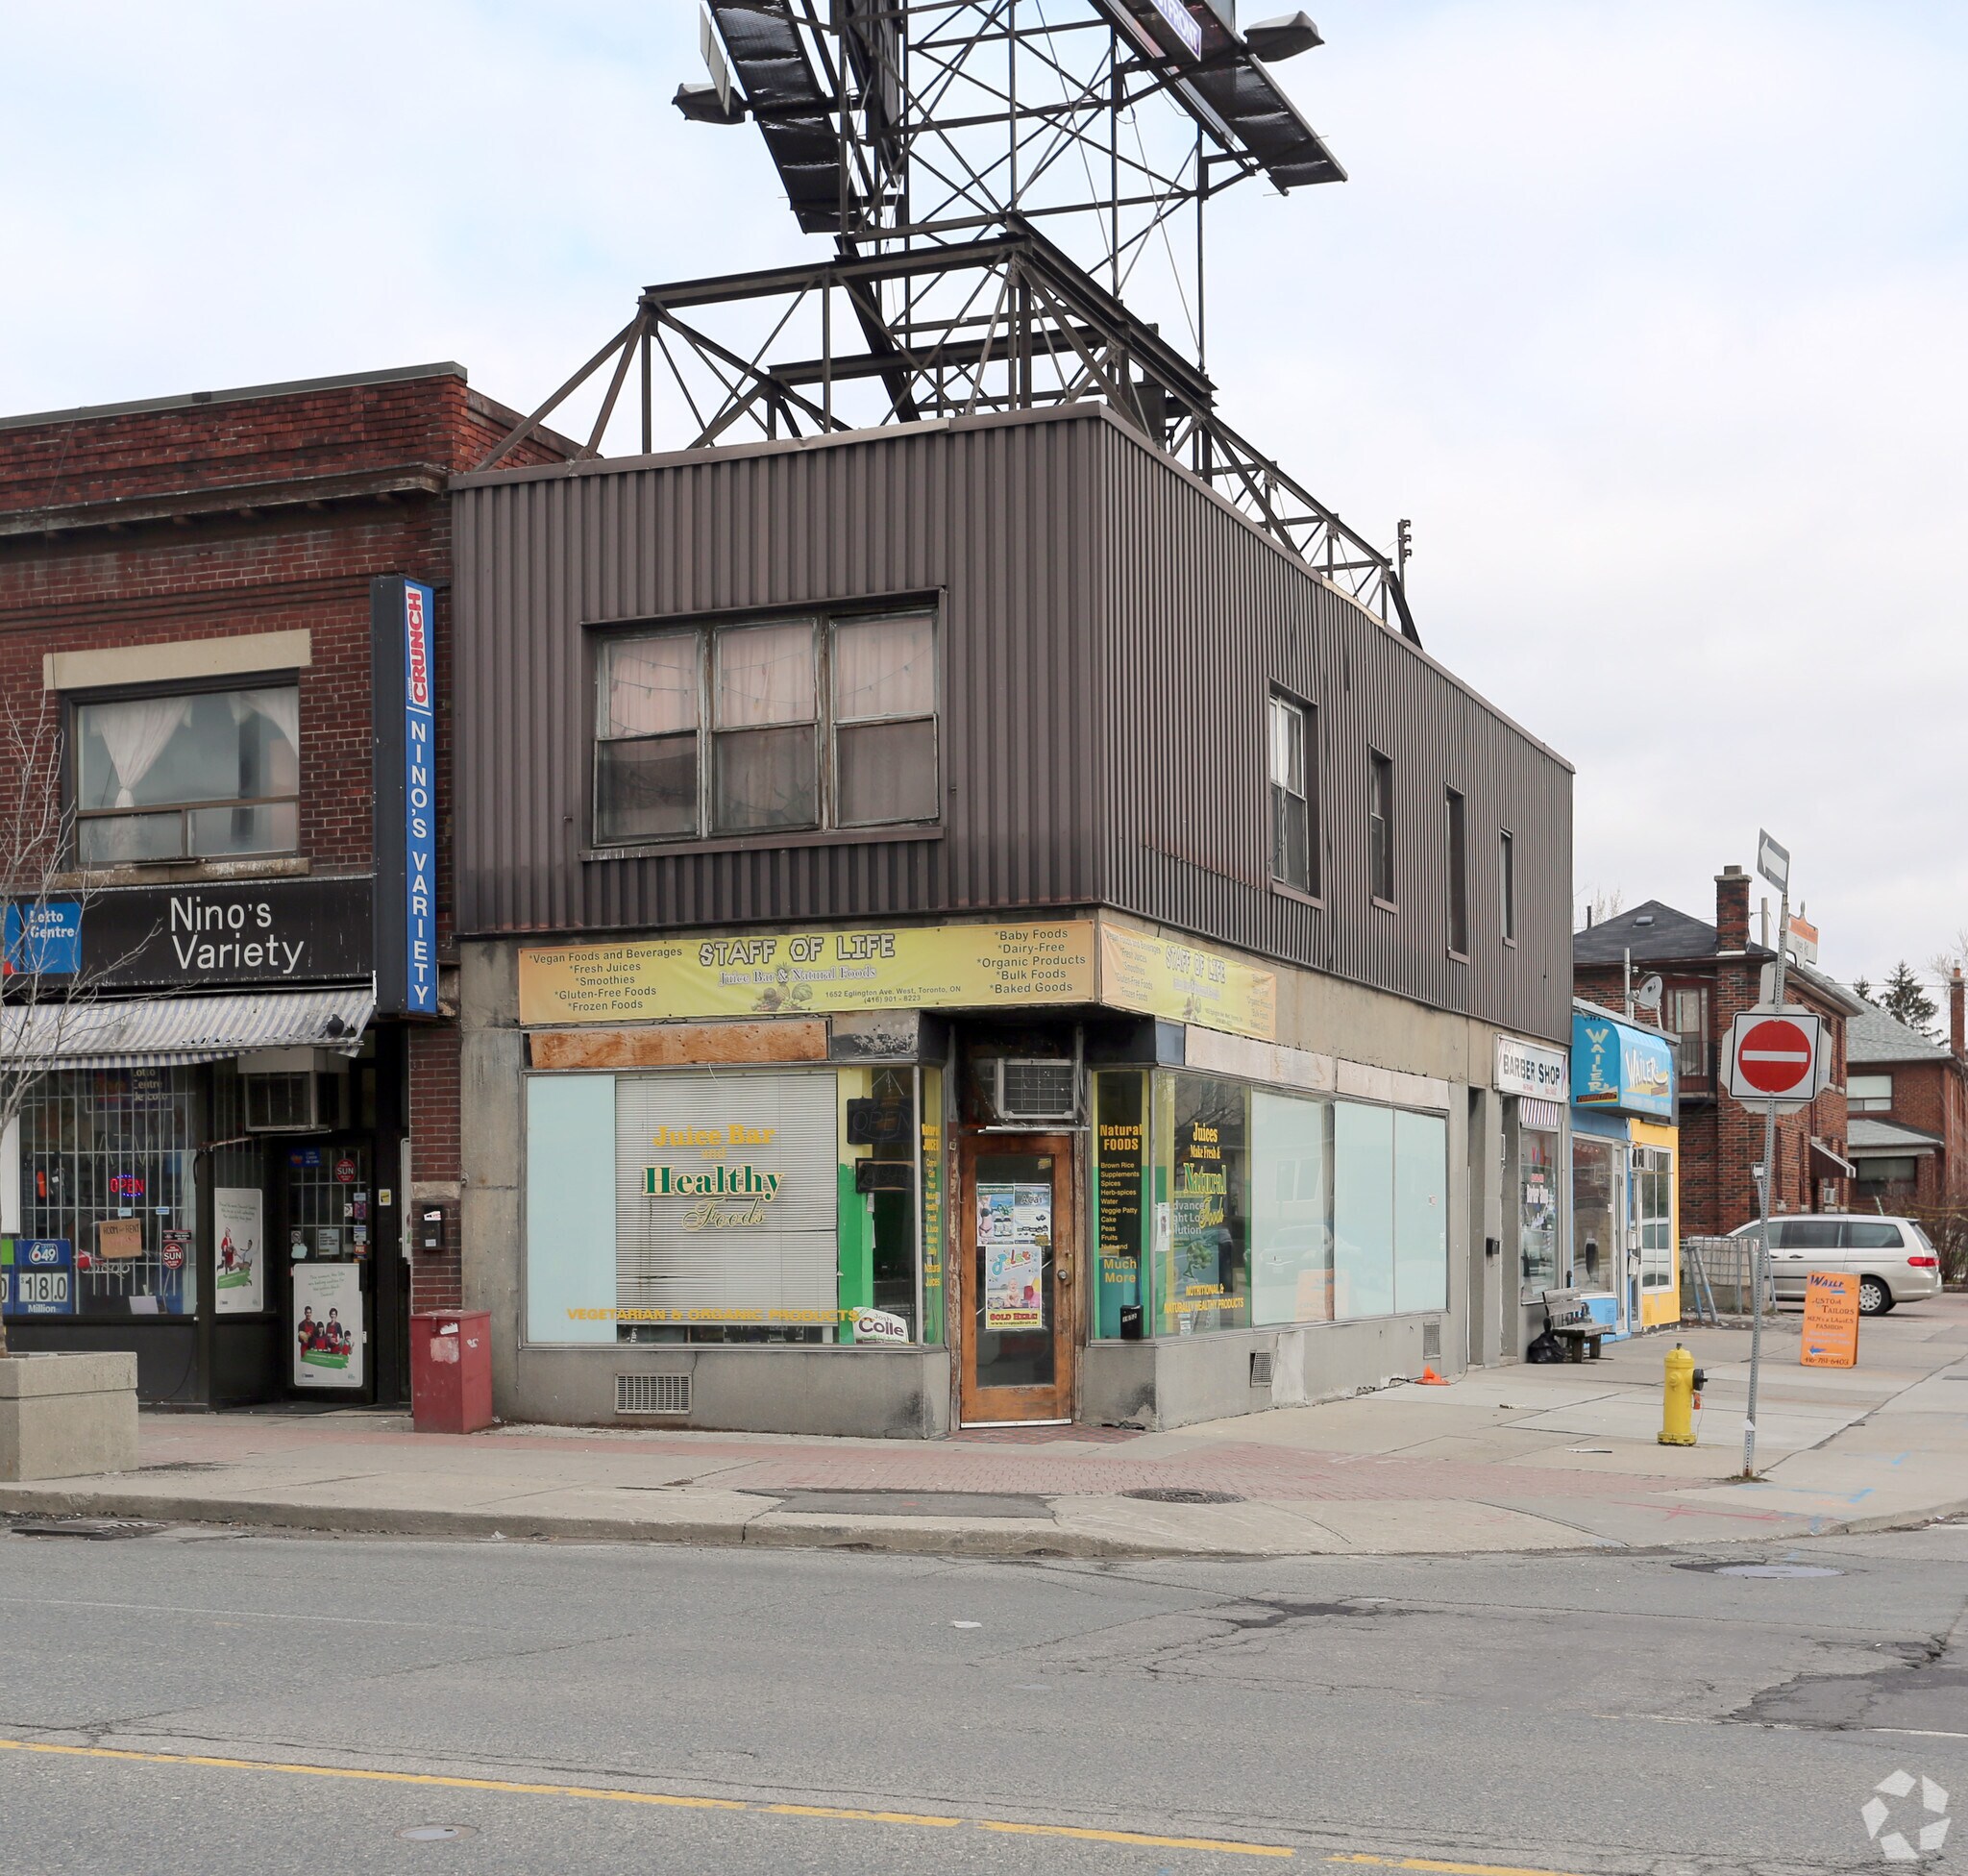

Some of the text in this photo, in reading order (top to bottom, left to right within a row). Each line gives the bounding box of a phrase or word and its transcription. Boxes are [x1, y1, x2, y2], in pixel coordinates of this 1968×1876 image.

[407, 592, 428, 704] CRUNCH
[410, 720, 430, 1005] NINO'S VARIETY
[170, 896, 272, 931] Nino's
[30, 925, 75, 938] Centre
[1032, 928, 1069, 940] Foods
[171, 932, 305, 975] Variety
[568, 950, 601, 962] Foods
[603, 949, 624, 960] and
[626, 947, 683, 960] Beverages
[699, 933, 896, 967] STAFF OF LIFE
[1032, 954, 1086, 966] Products
[1166, 945, 1226, 984] STAFF OF LIFE
[606, 962, 641, 973] Juices
[1031, 969, 1067, 979] Foods
[719, 971, 751, 986] Juice
[753, 970, 775, 983] Bar
[790, 967, 837, 981] Natural
[839, 965, 877, 980] Foods
[625, 985, 657, 997] Foods
[1035, 981, 1073, 992] Goods
[611, 999, 643, 1010] Foods
[864, 996, 883, 1004] (416)
[1503, 1053, 1561, 1086] BARBER SHOP
[652, 1123, 775, 1147] Juice Bar
[1099, 1123, 1144, 1137] Natural
[1193, 1122, 1218, 1143] Juices
[1103, 1138, 1139, 1150] FOODS
[701, 1146, 727, 1159] and
[1203, 1145, 1217, 1159] Fresh
[336, 1167, 354, 1175] SUN
[642, 1164, 785, 1201] Healthy
[1183, 1162, 1227, 1195] Natural
[110, 1177, 145, 1194] OPEN
[682, 1197, 765, 1231] Foods
[163, 1251, 182, 1260] SUN
[1103, 1258, 1138, 1270] Much
[1104, 1271, 1137, 1283] More
[1186, 1284, 1219, 1296] NUTRITIONAL
[28, 1303, 57, 1313] Million
[1218, 1297, 1244, 1309] PRODUCTS
[567, 1308, 667, 1321] VEGETARIAN
[687, 1309, 763, 1321] ORGANIC
[768, 1309, 860, 1322] PRODUCTS
[990, 1313, 1012, 1321] SOLD
[858, 1316, 904, 1337] Colle
